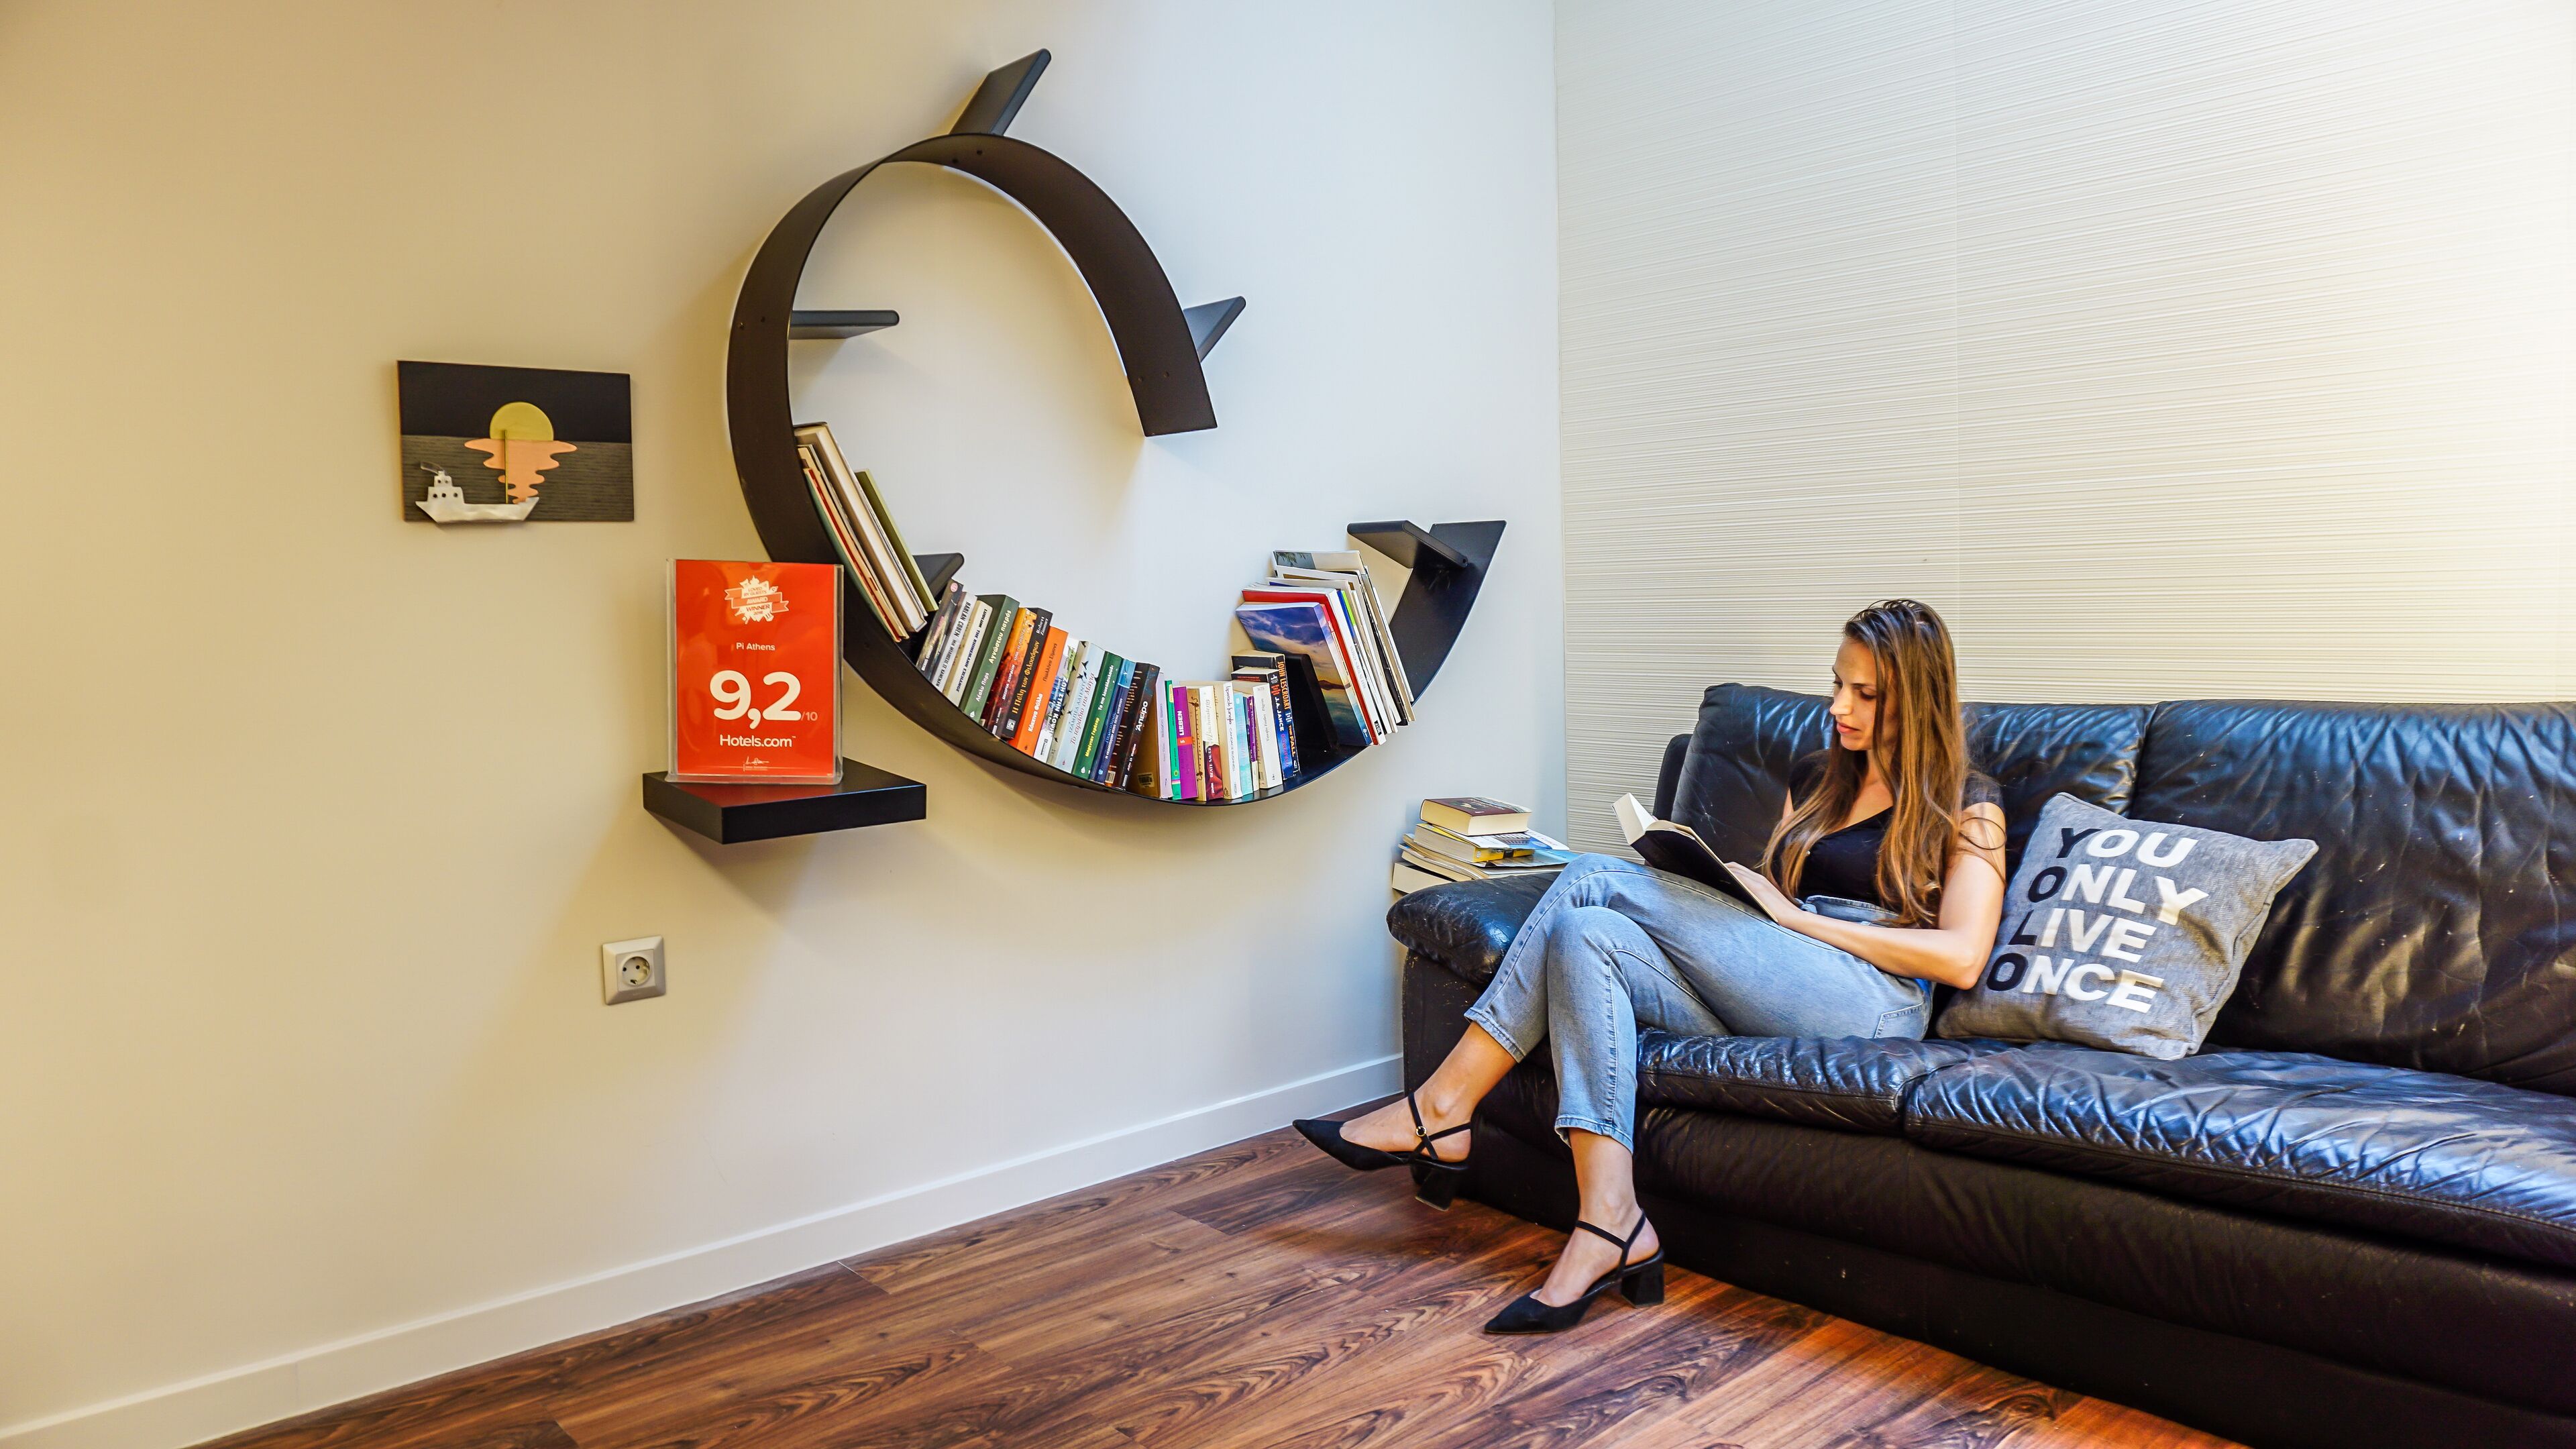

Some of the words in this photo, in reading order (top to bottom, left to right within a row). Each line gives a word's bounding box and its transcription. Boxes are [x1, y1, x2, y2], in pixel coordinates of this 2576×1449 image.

[959, 601, 971, 621] HARLAN
[977, 608, 987, 628] LUDLUM
[953, 621, 964, 637] COBEN
[986, 631, 1006, 664] Αγνώστου
[998, 608, 1013, 632] πατρός
[746, 643, 775, 651] Athens
[963, 638, 977, 667] RHINEMANN
[1022, 639, 1042, 676] Φιλοσόφων
[955, 667, 967, 692] EXCHANGE
[1277, 660, 1286, 677] JOHN
[1019, 676, 1029, 688] των
[1059, 676, 1069, 692] ΖΩΗ
[710, 670, 802, 730] 9,2
[1013, 688, 1026, 706] Πόλη
[1054, 692, 1064, 712] ΣΤΗΝ
[1279, 678, 1291, 710] LESCROART
[1011, 706, 1019, 714] Η
[1134, 700, 1150, 732] Άπειρο
[1276, 709, 1285, 731] JANCE
[1048, 712, 1059, 735] ΚΟΨΗ
[1176, 710, 1185, 736] LIEBEN
[1289, 735, 1297, 757] FALL
[2056, 827, 2199, 869] YOU
[2027, 863, 2209, 926] ONLY
[2009, 908, 2157, 963] LIVE
[1986, 952, 2165, 1014] ONCE
